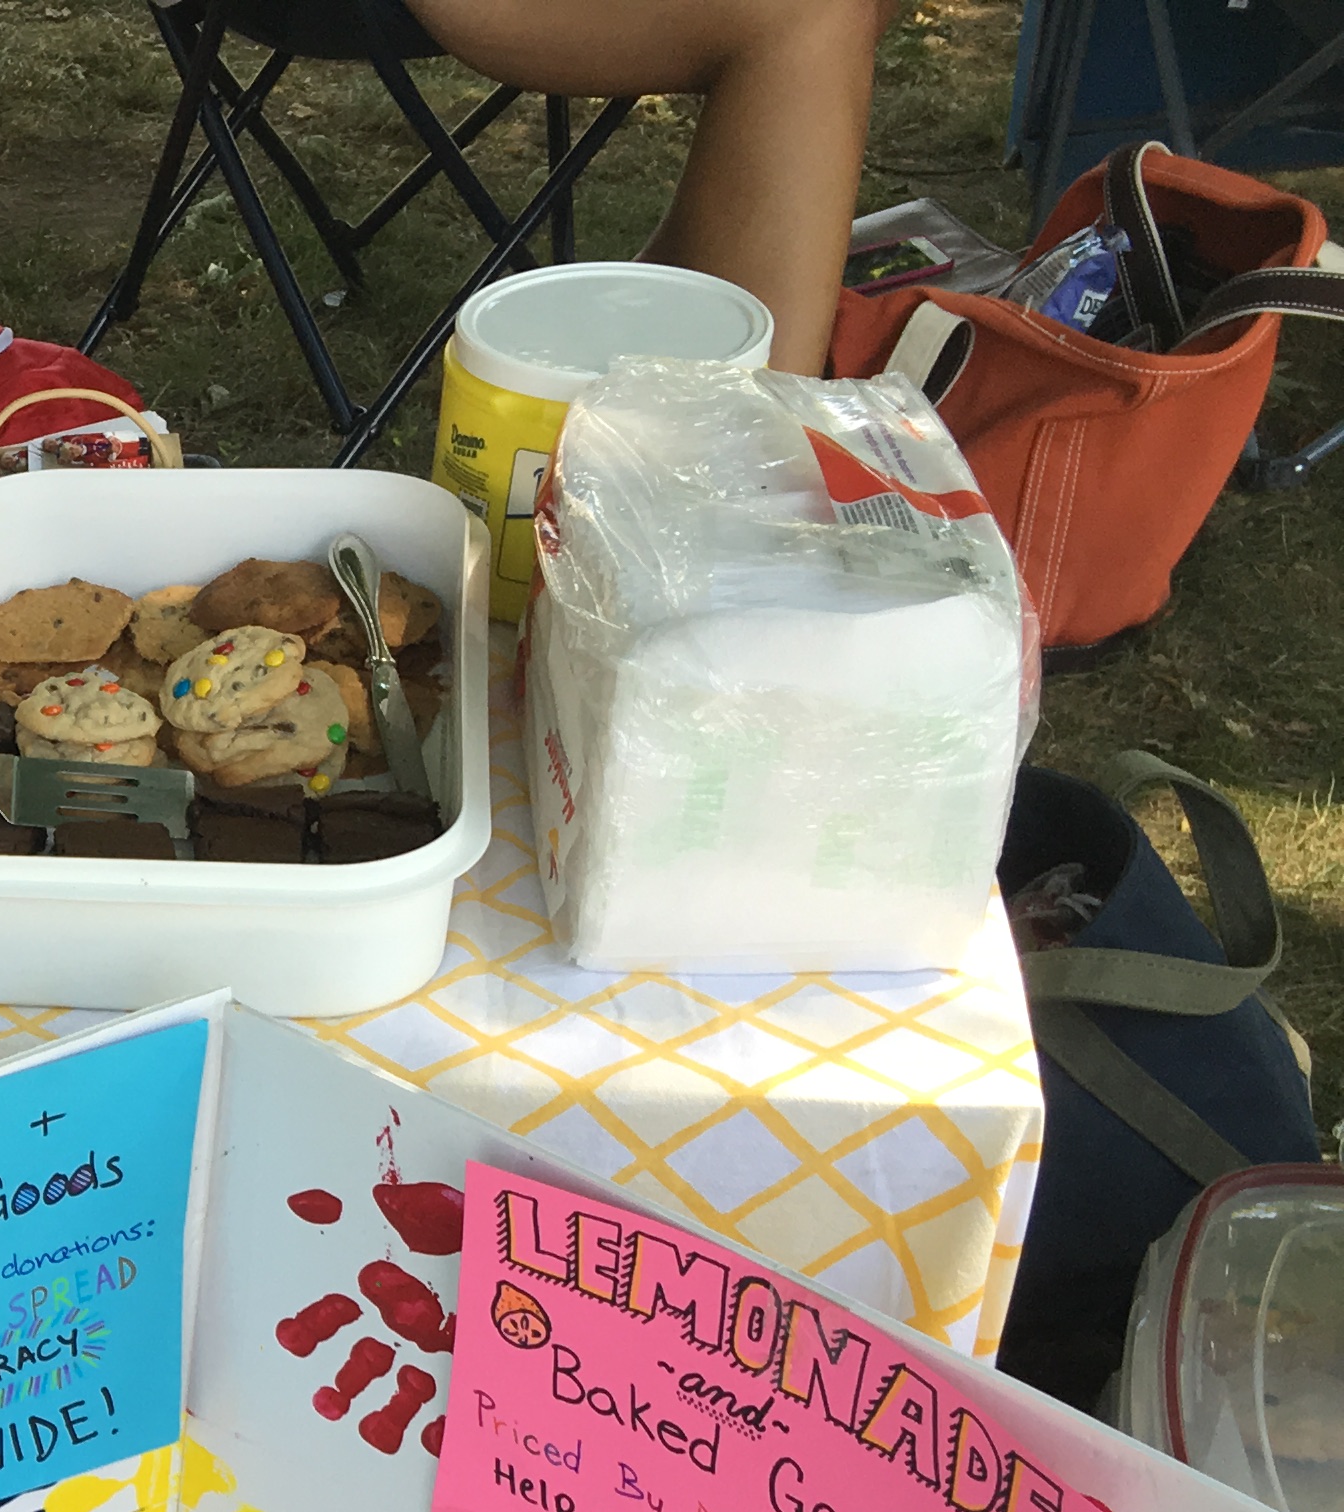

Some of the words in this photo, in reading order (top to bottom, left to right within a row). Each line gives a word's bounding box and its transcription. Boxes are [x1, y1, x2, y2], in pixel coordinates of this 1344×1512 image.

[1, 1217, 156, 1280] donations:
[8, 1256, 137, 1324] SPREAD
[473, 1391, 582, 1474] Priced
[552, 1345, 721, 1474] Baked
